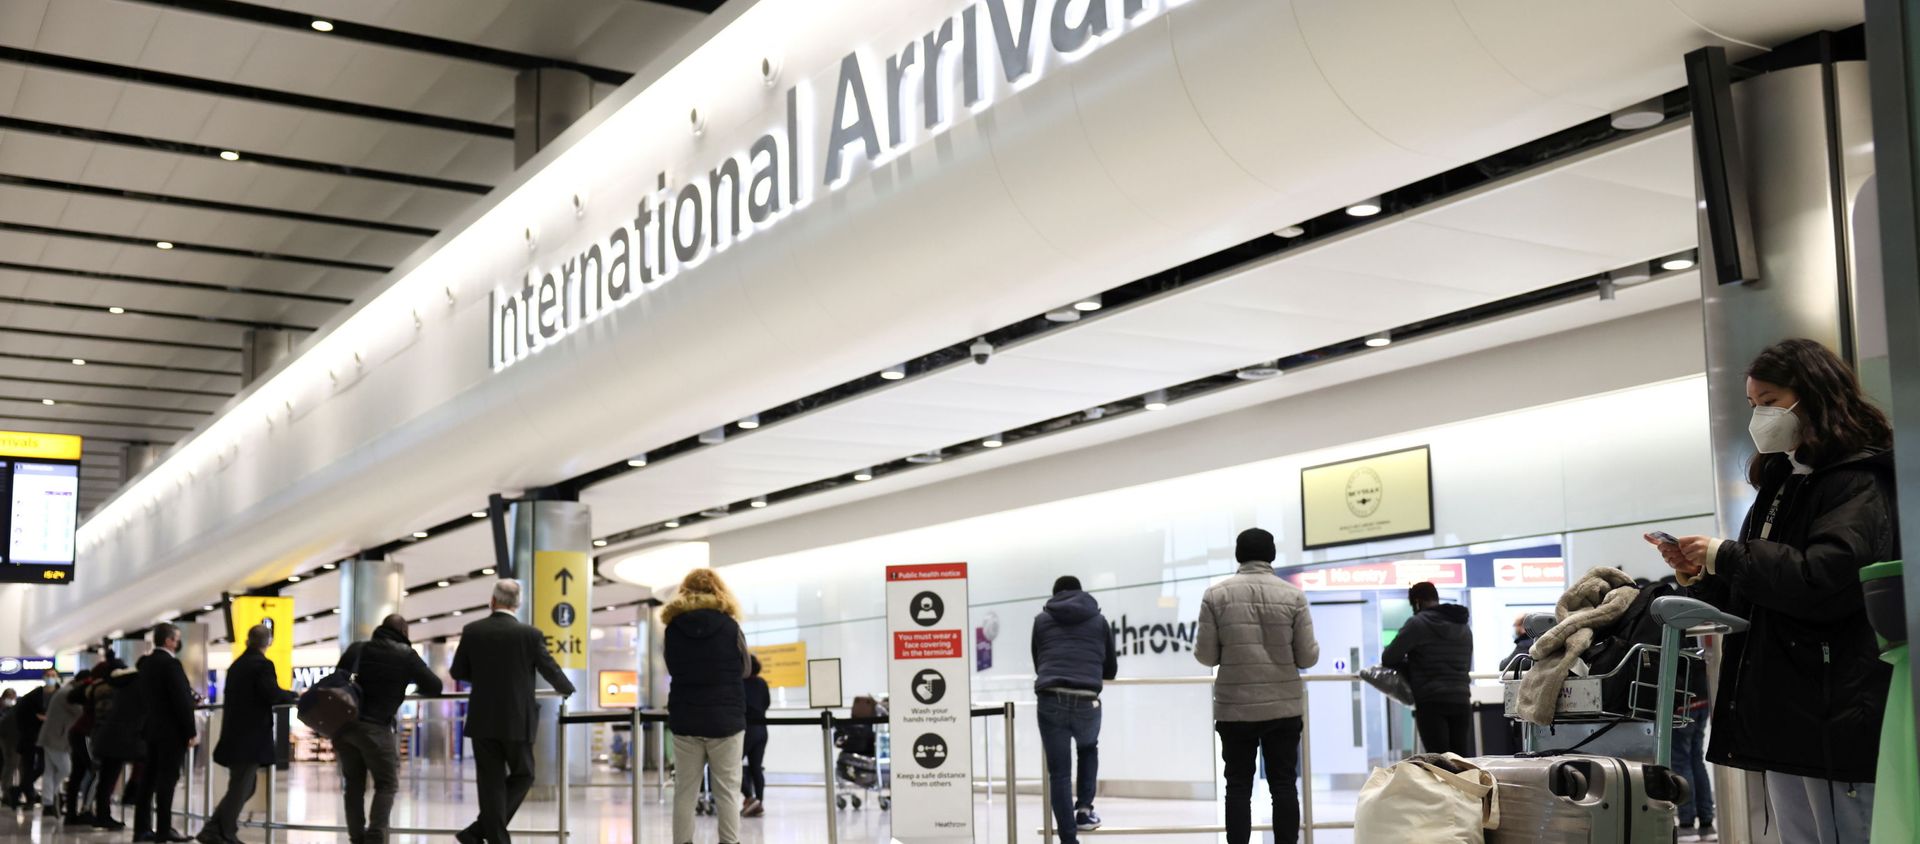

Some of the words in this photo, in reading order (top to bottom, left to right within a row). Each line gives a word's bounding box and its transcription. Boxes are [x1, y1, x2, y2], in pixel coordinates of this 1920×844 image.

[489, 85, 799, 370] International
[823, 0, 1144, 187] Arriva
[1330, 568, 1351, 583] No
[1352, 569, 1388, 586] entry
[543, 635, 582, 654] Exit
[920, 641, 951, 649] covering
[923, 648, 954, 656] terminal
